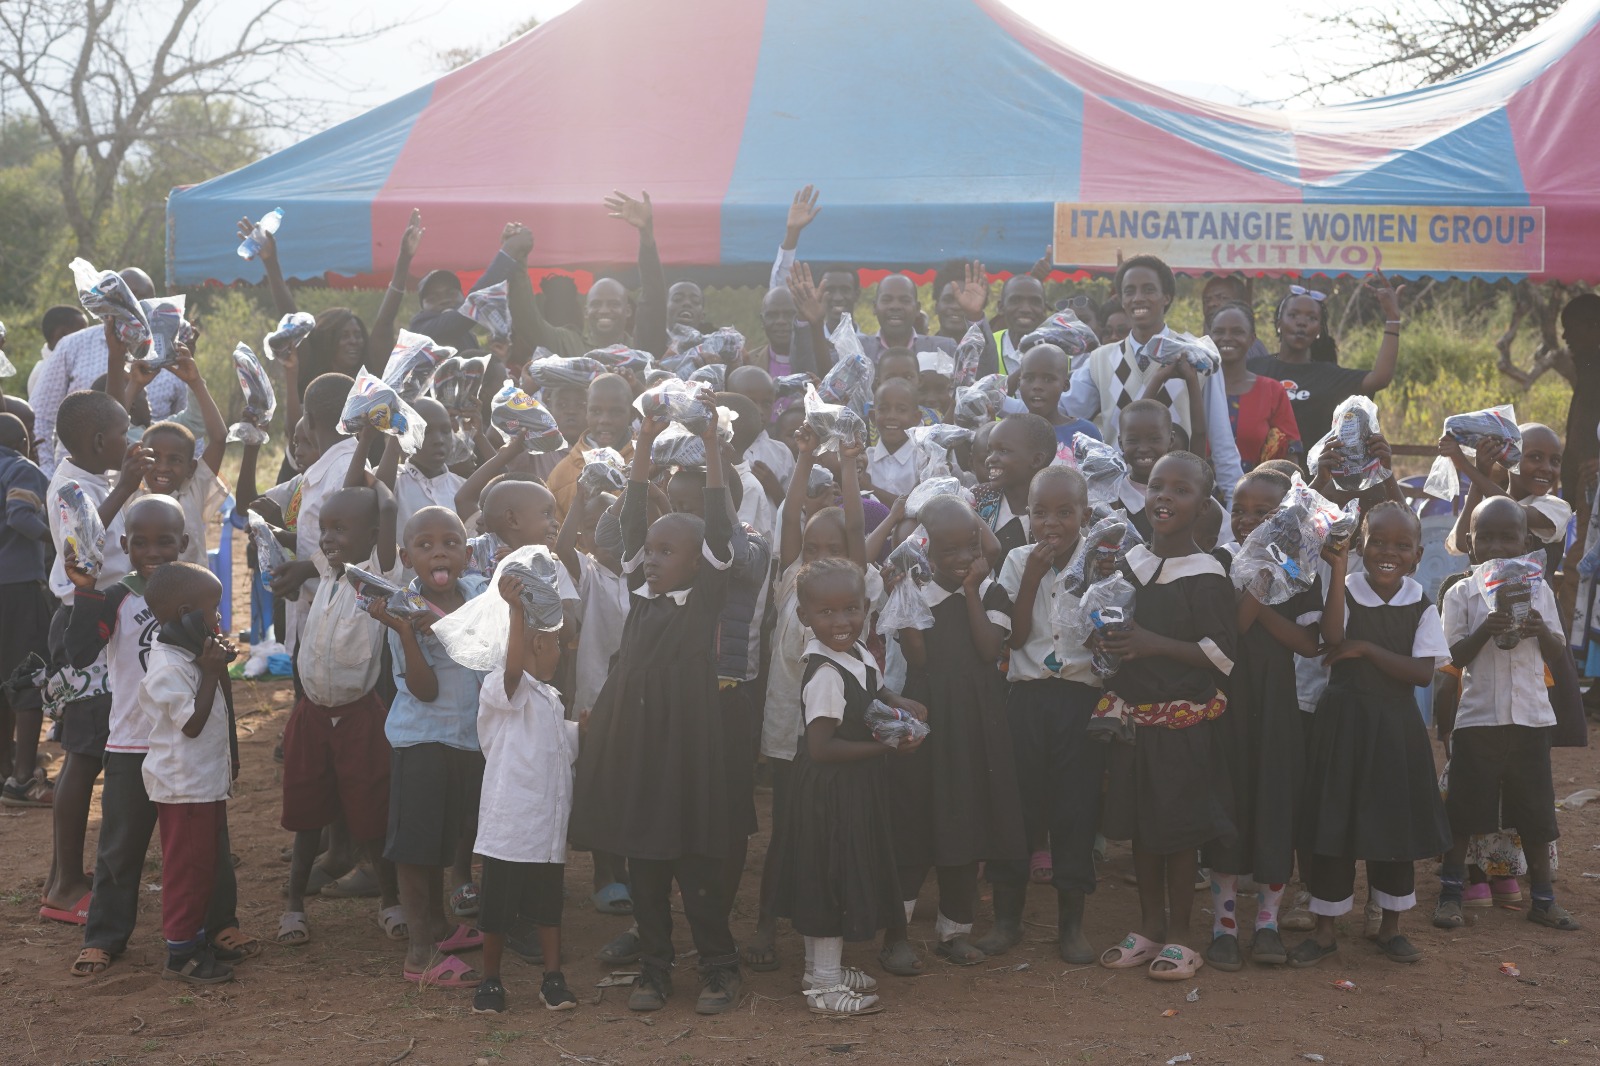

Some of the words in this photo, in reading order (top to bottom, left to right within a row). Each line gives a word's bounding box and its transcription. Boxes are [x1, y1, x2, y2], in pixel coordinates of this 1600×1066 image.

[1071, 209, 1294, 240] ITANGATANGIE
[1302, 213, 1418, 243] WOMEN
[1428, 214, 1536, 244] GROUP
[1211, 243, 1383, 270] (KITIVO)
